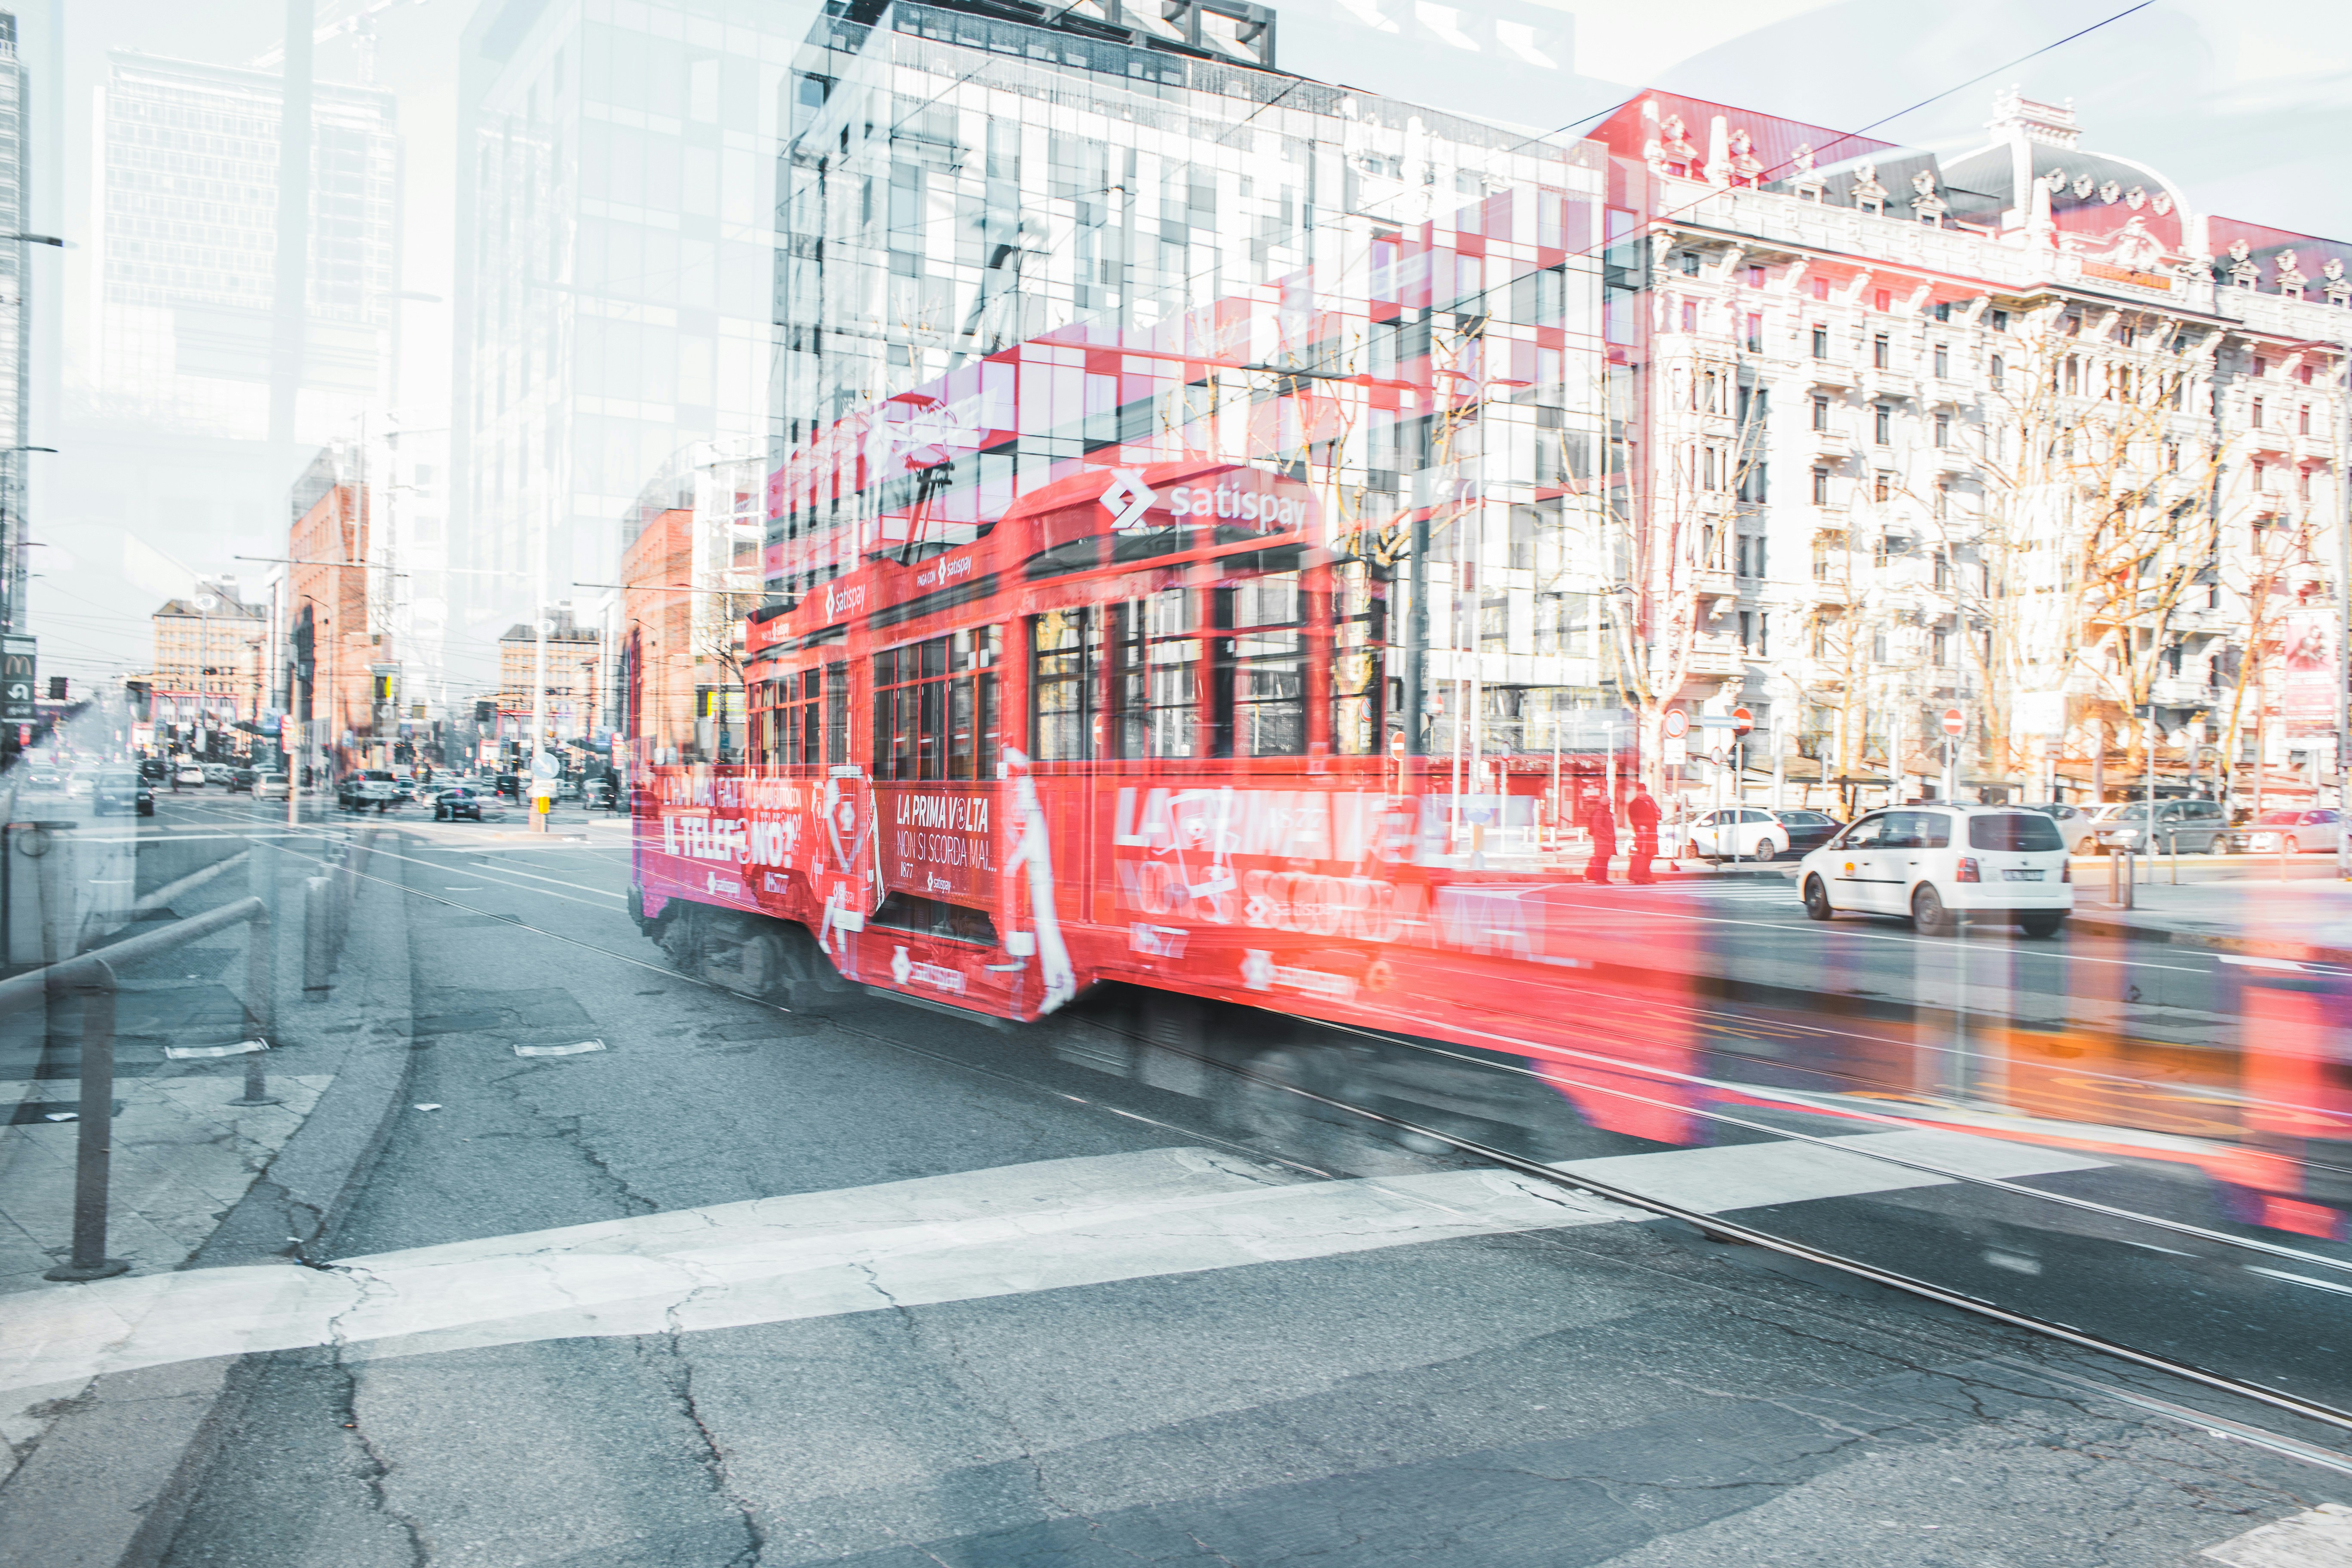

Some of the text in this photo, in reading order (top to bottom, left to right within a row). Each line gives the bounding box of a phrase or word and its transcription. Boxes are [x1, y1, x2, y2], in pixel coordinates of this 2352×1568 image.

[1170, 481, 1306, 538] satispay
[917, 554, 972, 588] PAGA CON satispay
[836, 583, 865, 616] satispay
[897, 794, 988, 833] LA PRIMA VOLTA
[897, 830, 997, 873] NON SI SCORDA MAI...
[900, 861, 914, 879] 1877
[933, 876, 951, 894] satispay
